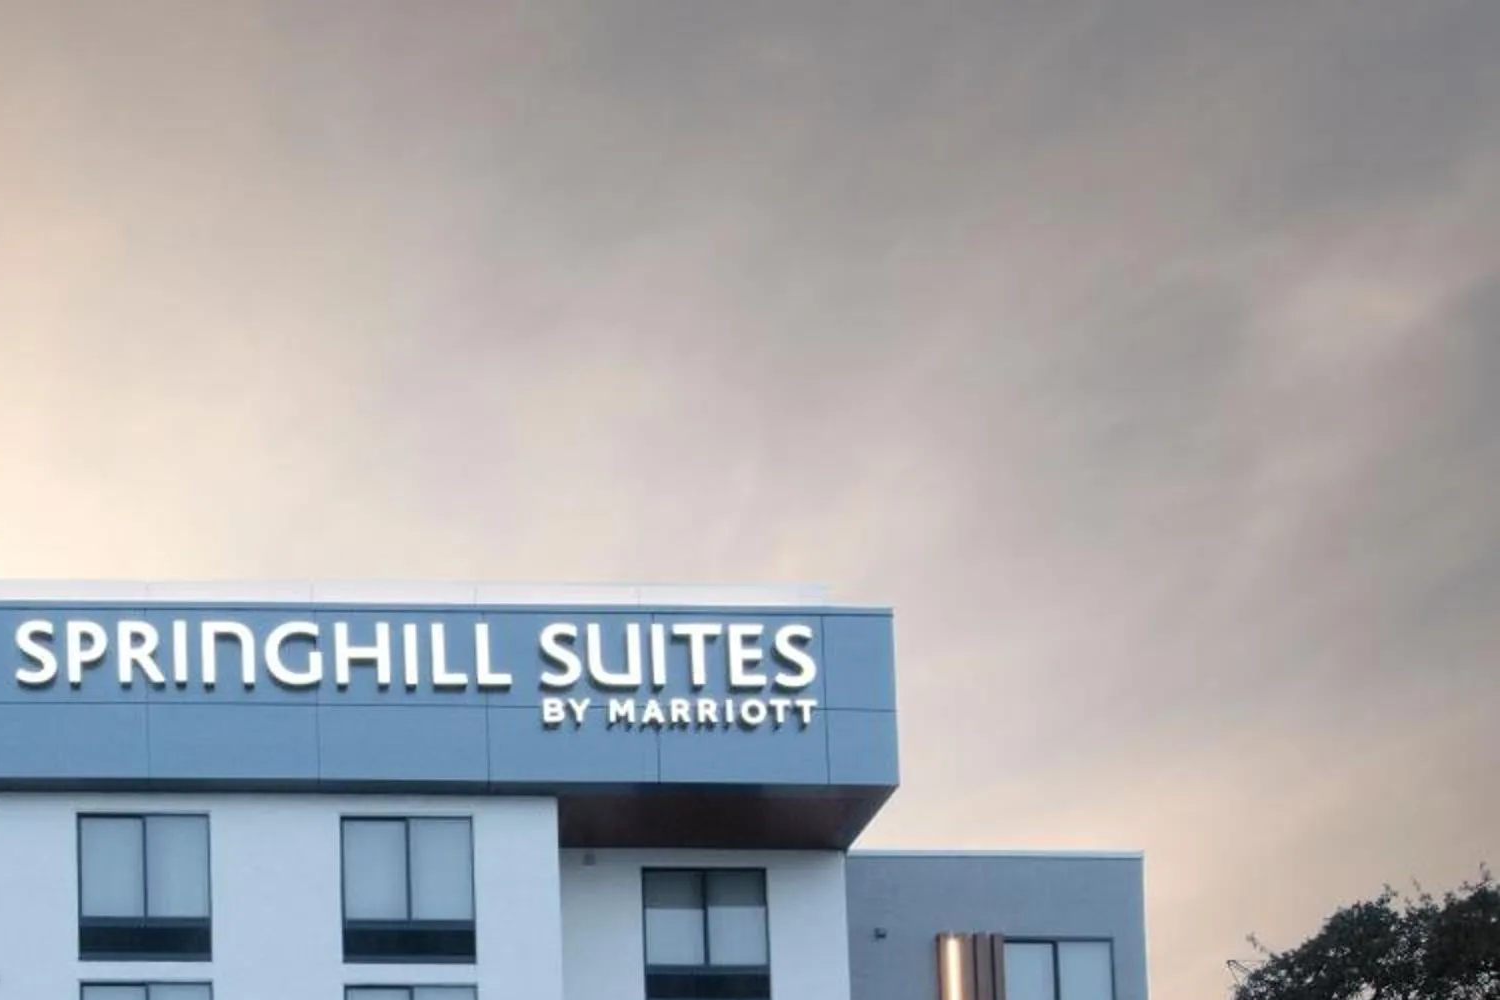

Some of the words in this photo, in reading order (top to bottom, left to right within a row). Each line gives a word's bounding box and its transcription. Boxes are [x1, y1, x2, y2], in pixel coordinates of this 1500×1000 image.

[15, 619, 512, 687] SPRINGHILL
[539, 622, 817, 689] SUITES
[542, 697, 591, 726] BY
[608, 698, 818, 729] MARRIOTT
